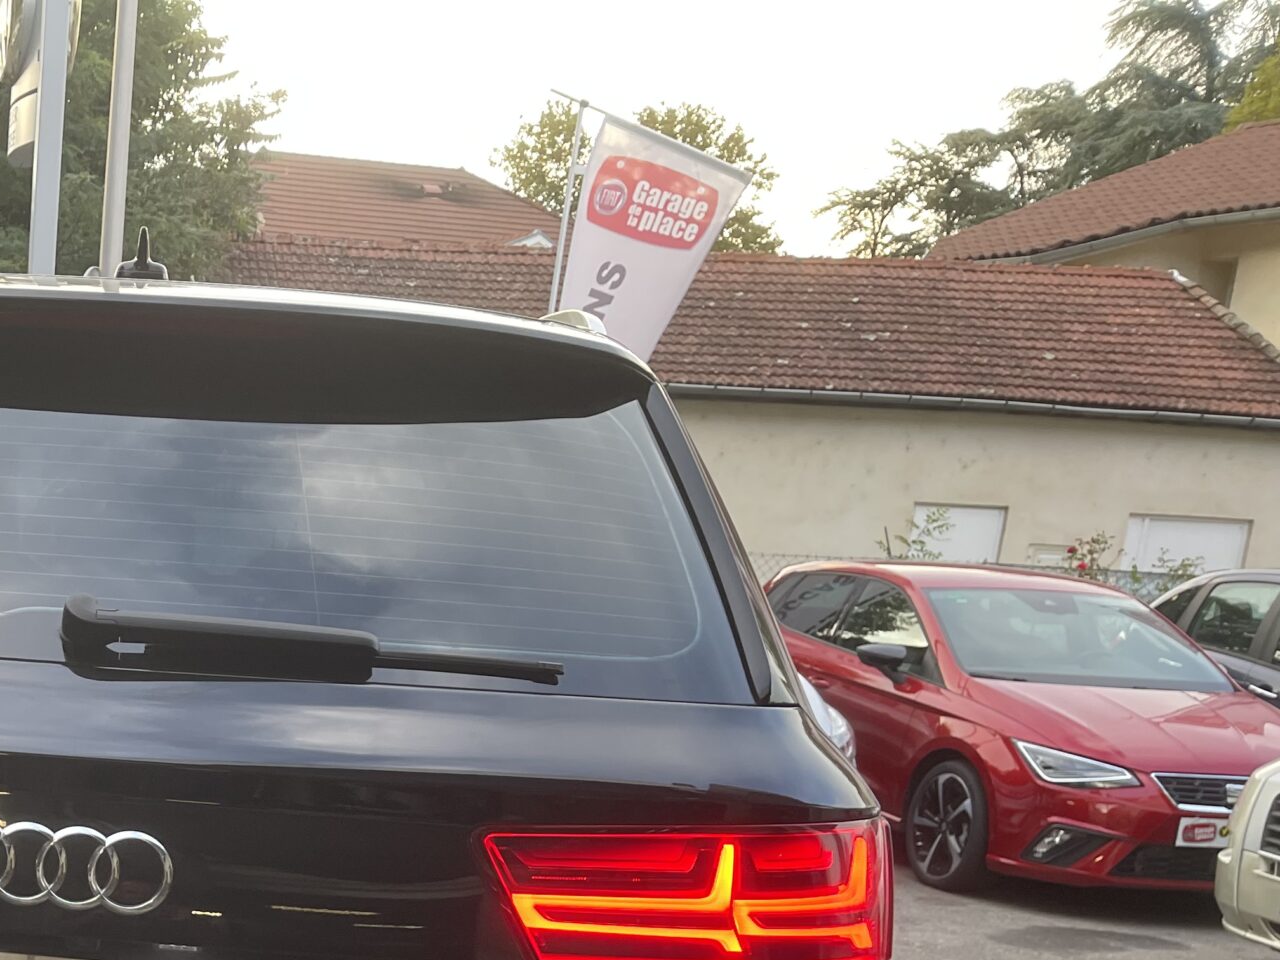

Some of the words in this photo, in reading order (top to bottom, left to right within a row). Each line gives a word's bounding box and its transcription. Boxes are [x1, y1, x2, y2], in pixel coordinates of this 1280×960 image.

[628, 203, 642, 216] de
[632, 180, 709, 220] Garage
[626, 213, 639, 227] la
[637, 209, 700, 242] place
